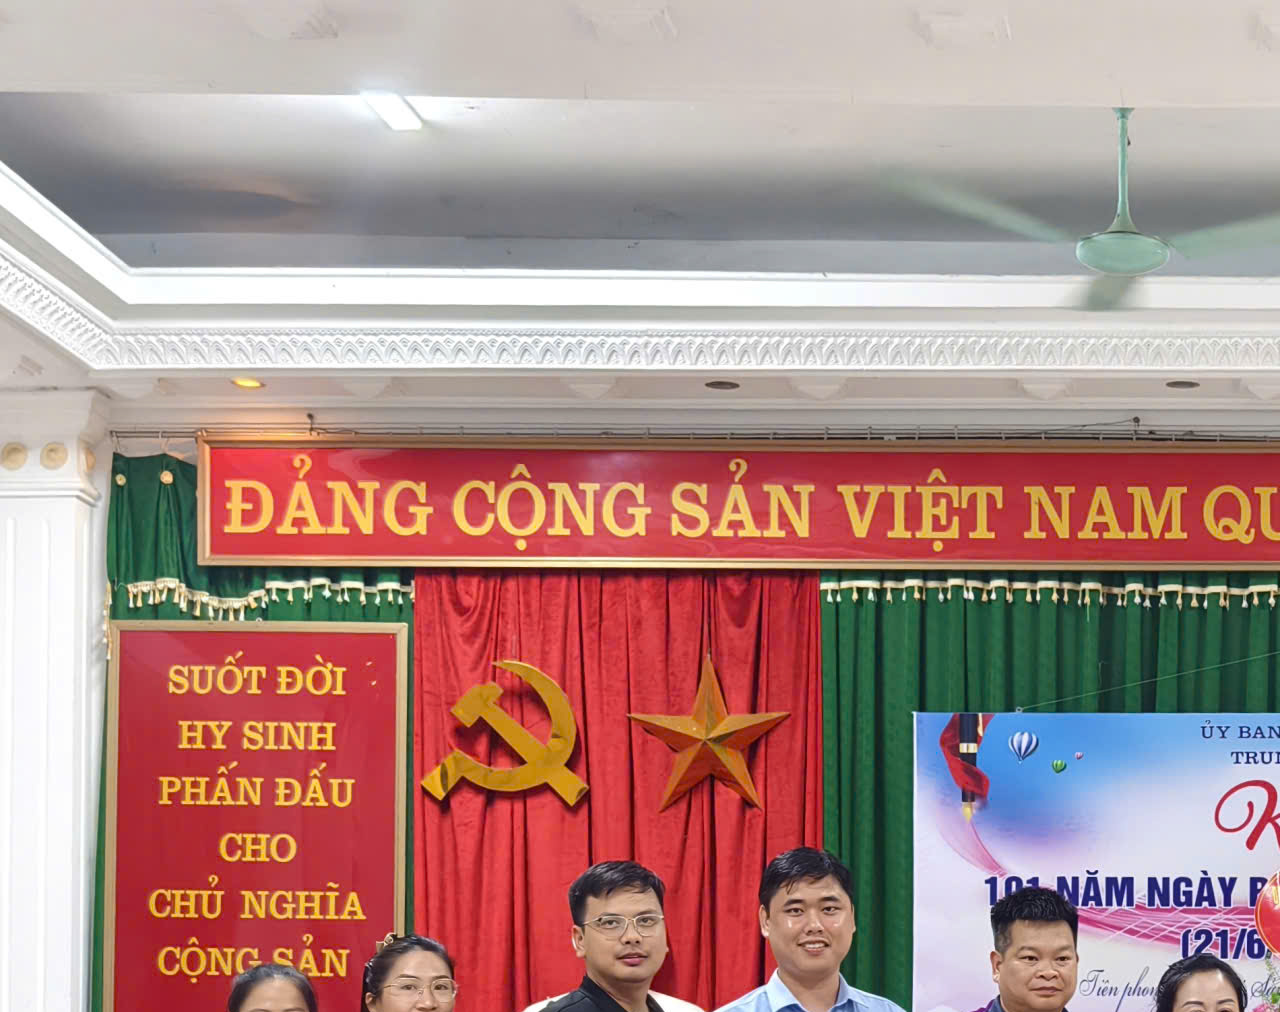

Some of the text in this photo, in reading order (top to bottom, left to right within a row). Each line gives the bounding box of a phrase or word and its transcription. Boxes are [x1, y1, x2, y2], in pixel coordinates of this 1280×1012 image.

[223, 455, 434, 537] ĐẢNG
[451, 463, 648, 552] CỘNG
[670, 457, 815, 539] SẢN
[837, 468, 1004, 552] VIỆT
[1023, 486, 1188, 540] NAM
[168, 650, 347, 696] SUỐT ĐỜI
[178, 720, 337, 751] HY SINH
[1200, 718, 1231, 739] ỦY
[158, 761, 356, 808] PHẤN ĐẤU
[219, 833, 297, 863] CHO
[149, 874, 367, 920] CHỦ NGHĨA
[1056, 869, 1134, 907] NĂM
[1147, 870, 1238, 908] NGÀY
[158, 933, 350, 983] CỘNG SẢN
[1079, 969, 1119, 997] Tiên
